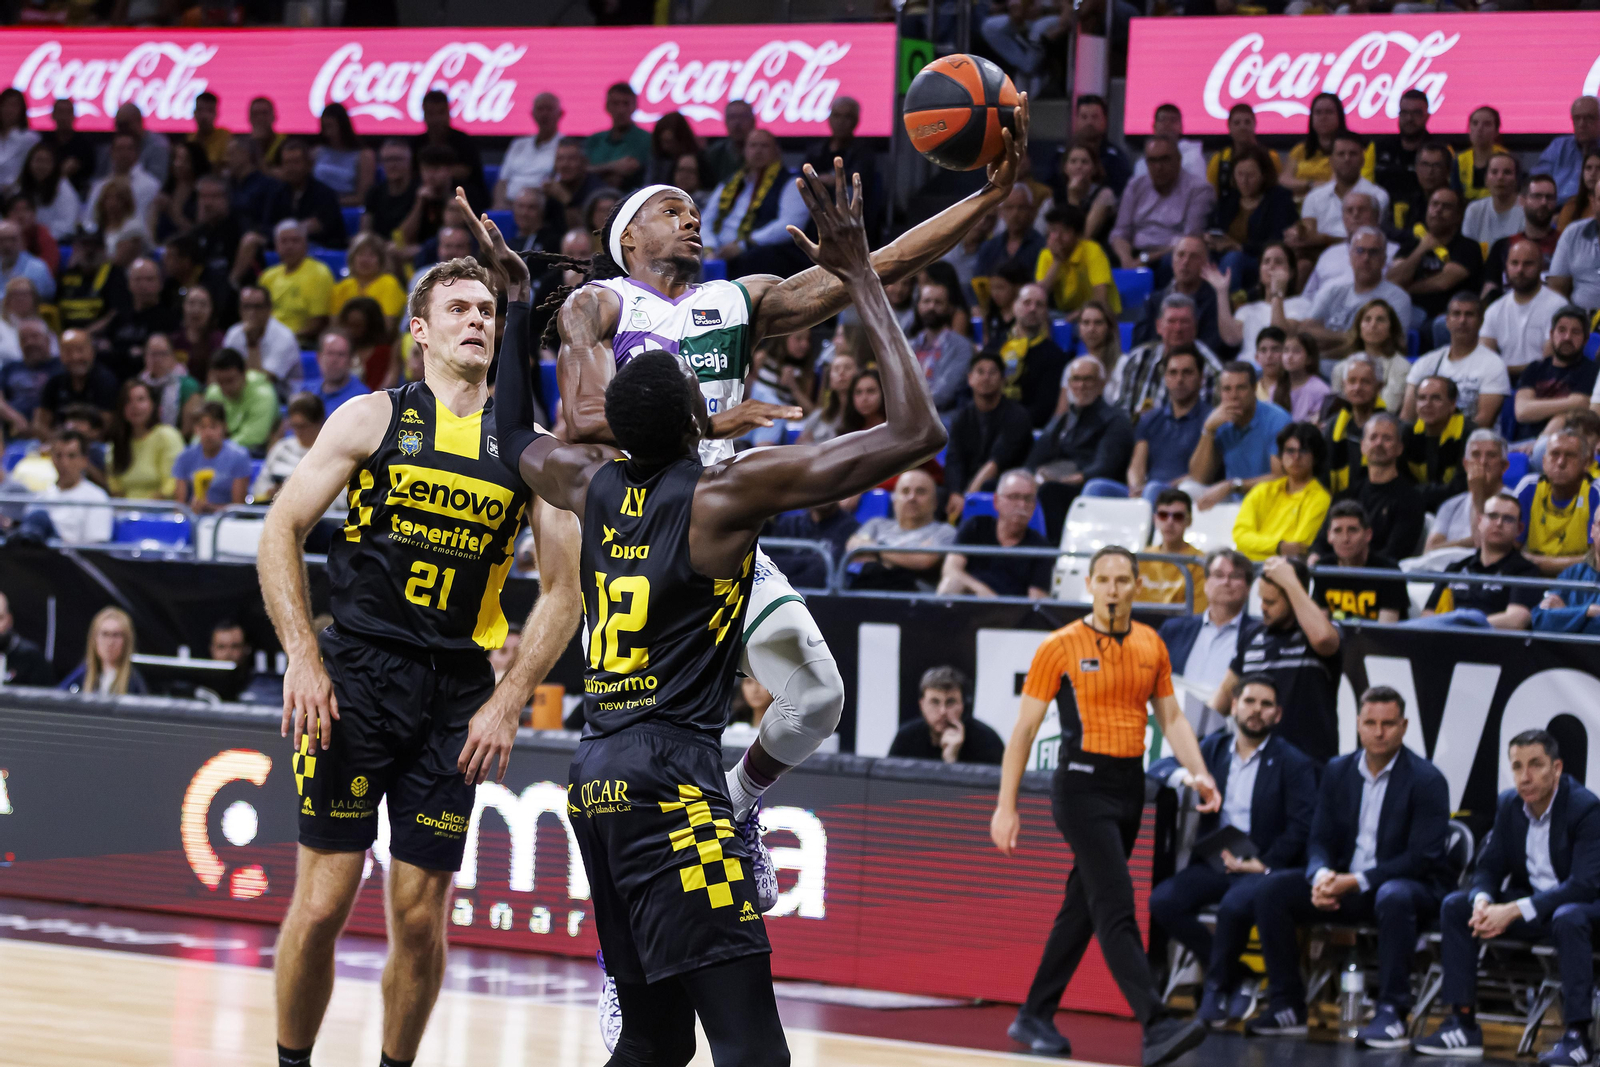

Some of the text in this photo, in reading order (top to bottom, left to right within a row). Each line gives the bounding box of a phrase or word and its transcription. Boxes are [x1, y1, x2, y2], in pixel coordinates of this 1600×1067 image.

[678, 348, 728, 372] icaja
[390, 472, 504, 521] Lenovo
[388, 532, 430, 550] despierta
[405, 561, 456, 611] 21
[590, 571, 650, 674] 12
[599, 695, 657, 711] new travel
[581, 780, 631, 808] CICAR
[330, 809, 360, 819] deporte
[331, 800, 344, 809] LA
[616, 803, 632, 812] Car
[416, 813, 463, 833] Canarias
[441, 811, 465, 824] Islas
